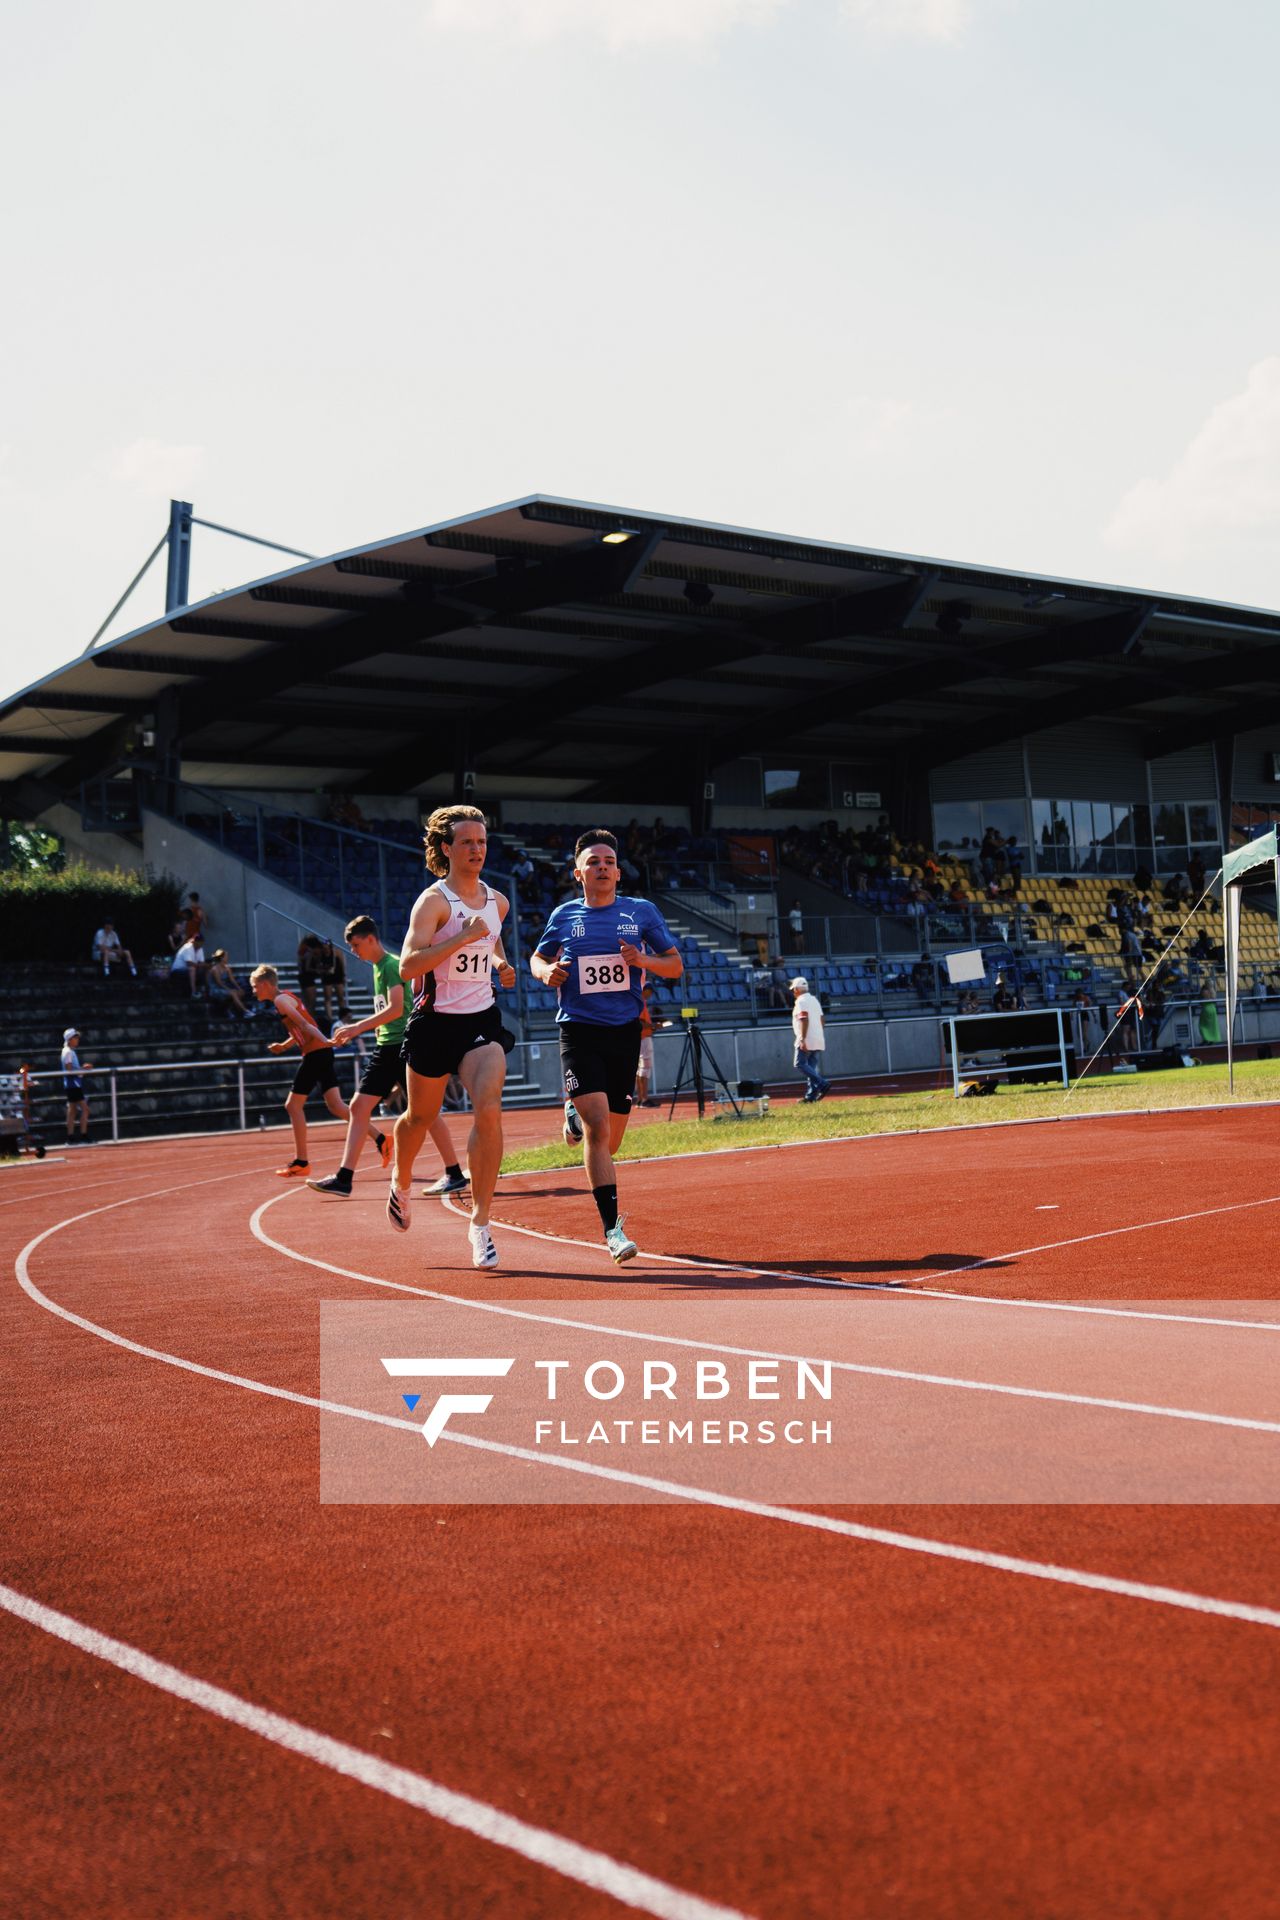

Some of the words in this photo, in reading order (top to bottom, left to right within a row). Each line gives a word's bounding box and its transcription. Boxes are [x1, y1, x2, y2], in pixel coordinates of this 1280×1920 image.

[465, 774, 474, 787] A
[571, 925, 586, 938] OTB
[455, 953, 489, 973] 311
[585, 964, 625, 986] 388
[566, 1075, 579, 1092] OTB
